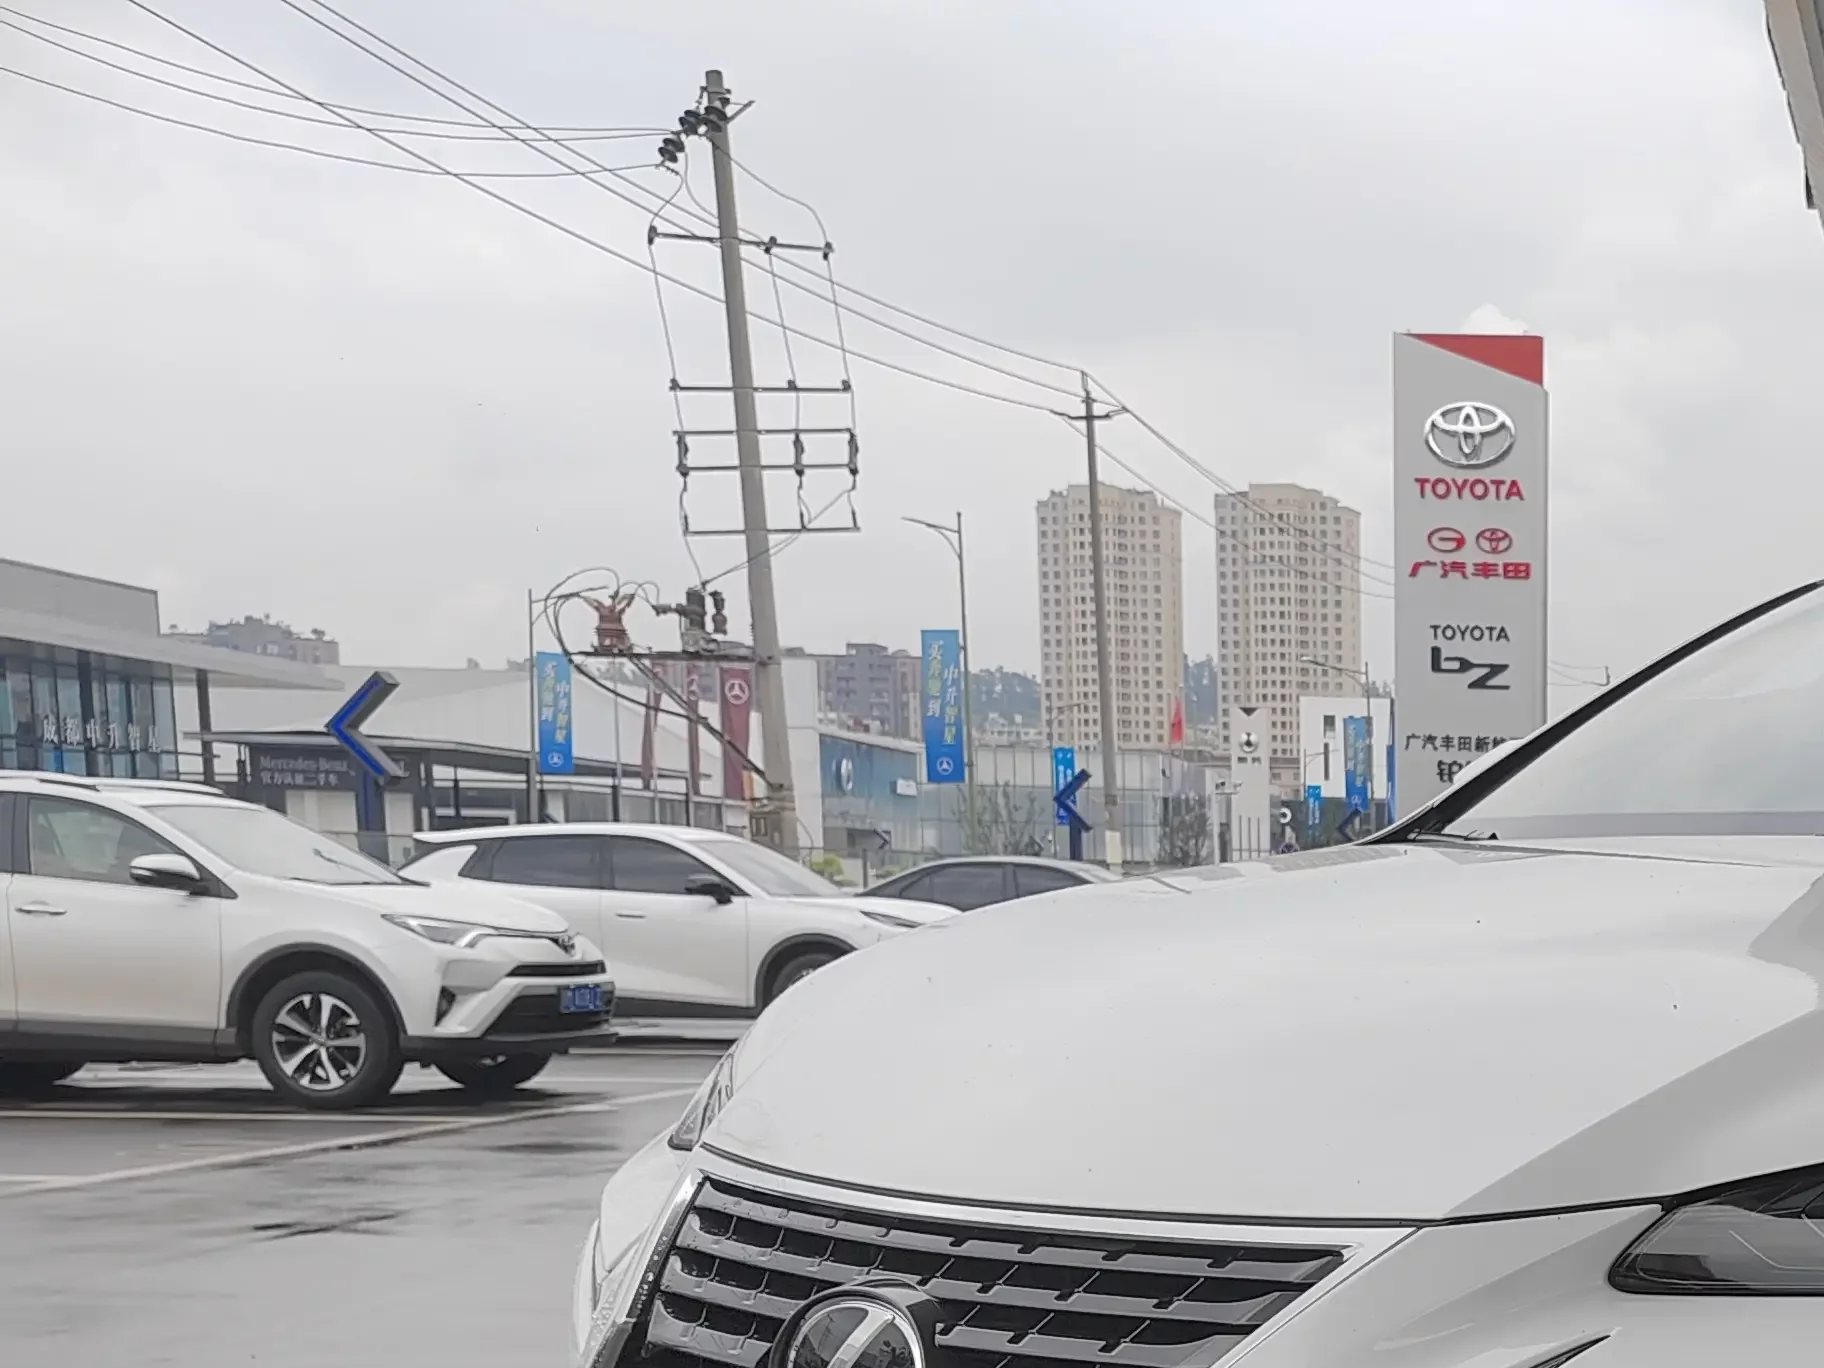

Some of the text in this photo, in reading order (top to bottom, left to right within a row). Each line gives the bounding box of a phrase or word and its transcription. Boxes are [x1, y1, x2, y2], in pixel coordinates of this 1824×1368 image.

[1414, 477, 1525, 501] TOYOTA
[1408, 560, 1531, 580] 广汽丰田
[1429, 624, 1511, 642] TOYOTA
[1404, 732, 1523, 752] 广汽丰田新
